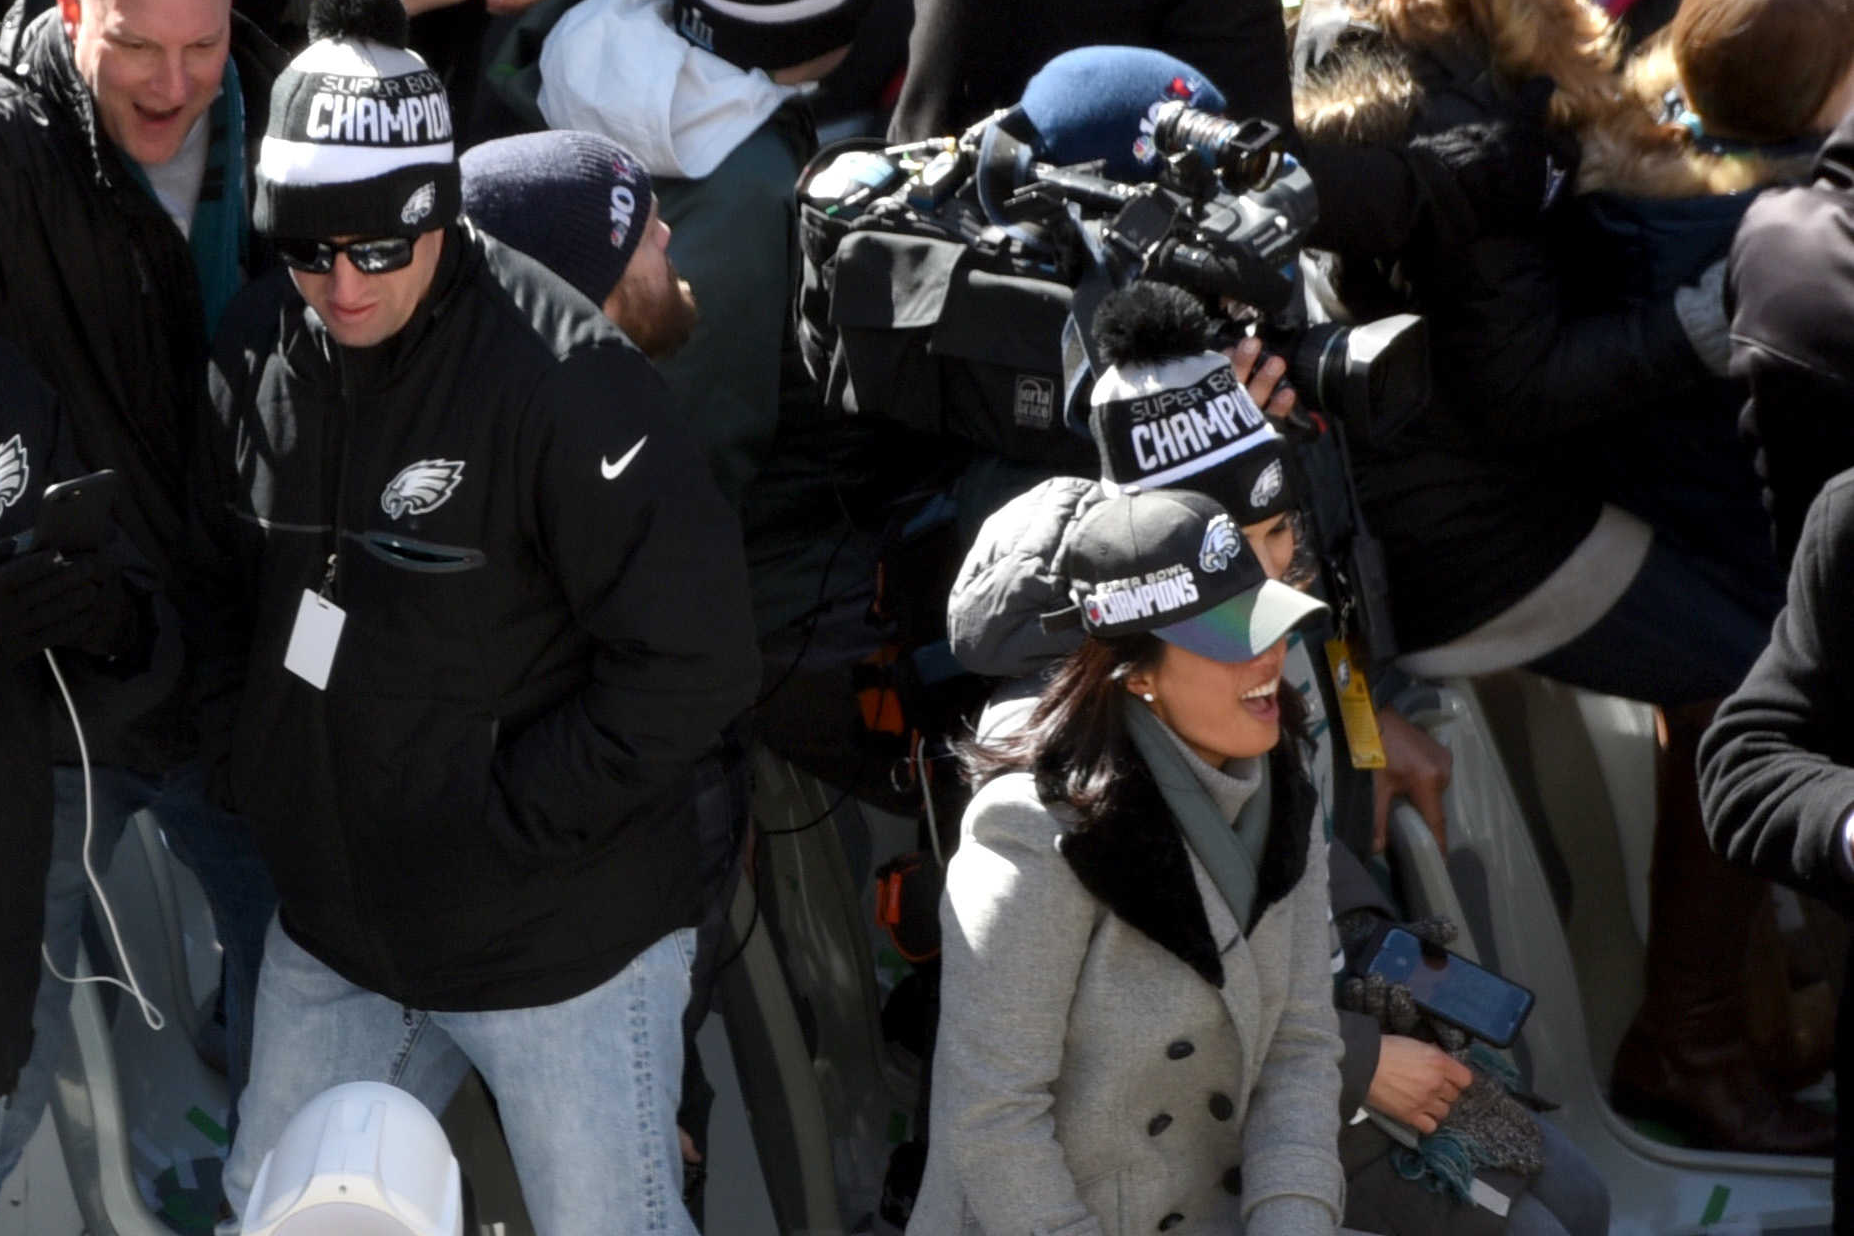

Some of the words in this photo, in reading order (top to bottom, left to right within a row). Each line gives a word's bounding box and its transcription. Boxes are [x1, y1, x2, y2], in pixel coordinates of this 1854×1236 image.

[320, 74, 401, 99] SUPER
[1130, 386, 1208, 422] SUPER
[1145, 563, 1190, 585] BOWL
[1101, 571, 1200, 625] CHAMPIONS
